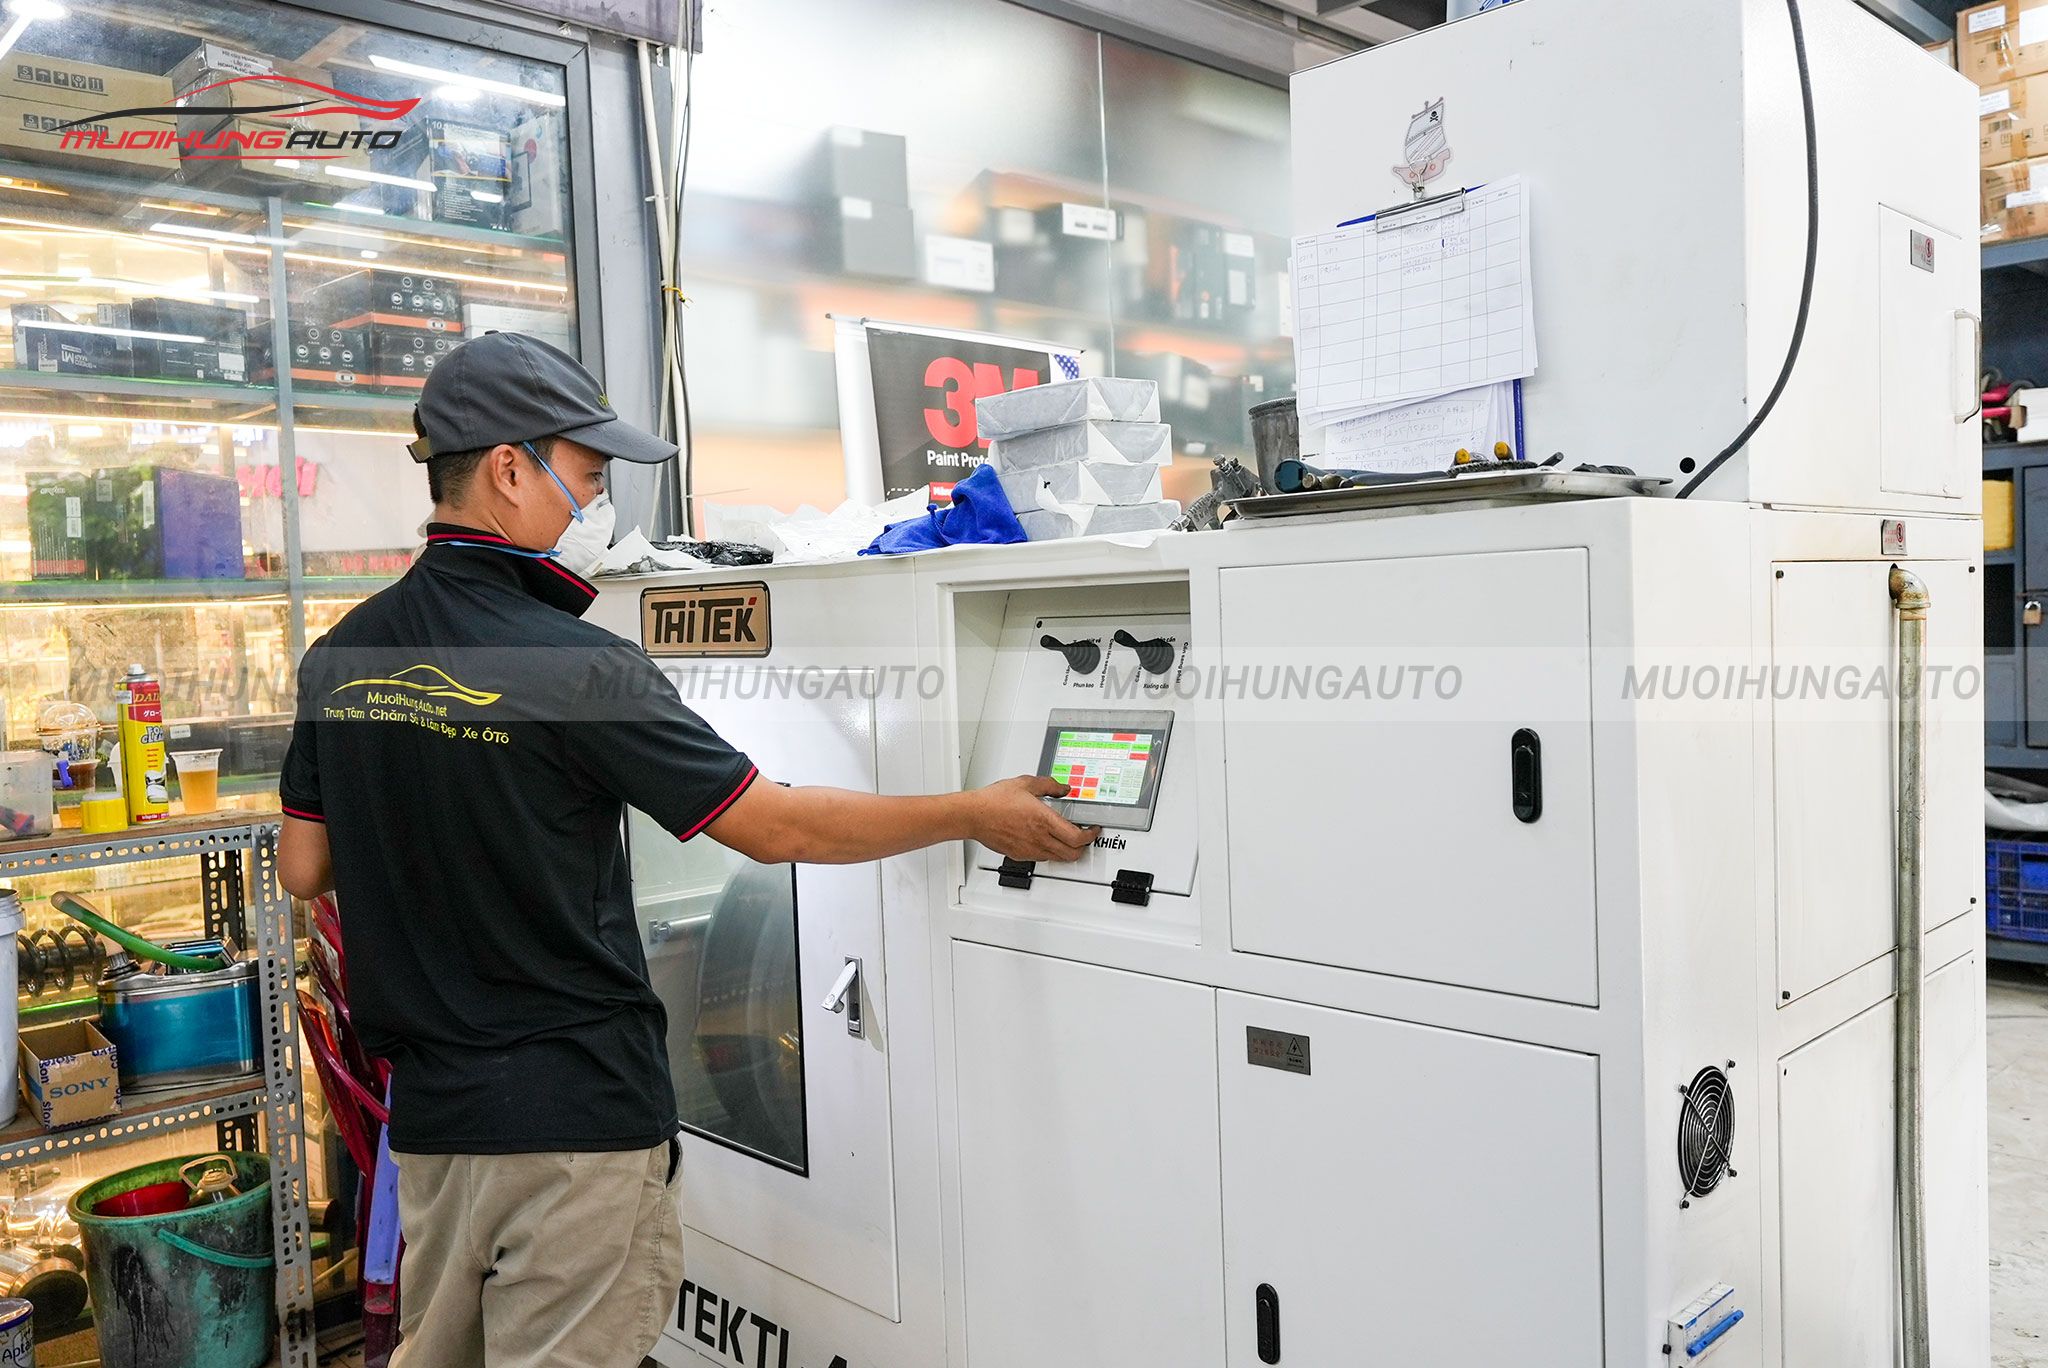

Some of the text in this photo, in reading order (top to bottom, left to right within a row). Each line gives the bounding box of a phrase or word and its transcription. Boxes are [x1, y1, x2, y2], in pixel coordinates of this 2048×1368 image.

[927, 450, 959, 467] Paint
[143, 709, 161, 718] グロー
[323, 707, 344, 721] Trung
[345, 706, 365, 719] Tâm
[369, 708, 407, 722] Chăm
[462, 726, 478, 740] Xe
[1093, 834, 1127, 850] KHIỂN
[49, 1077, 110, 1099] SONY
